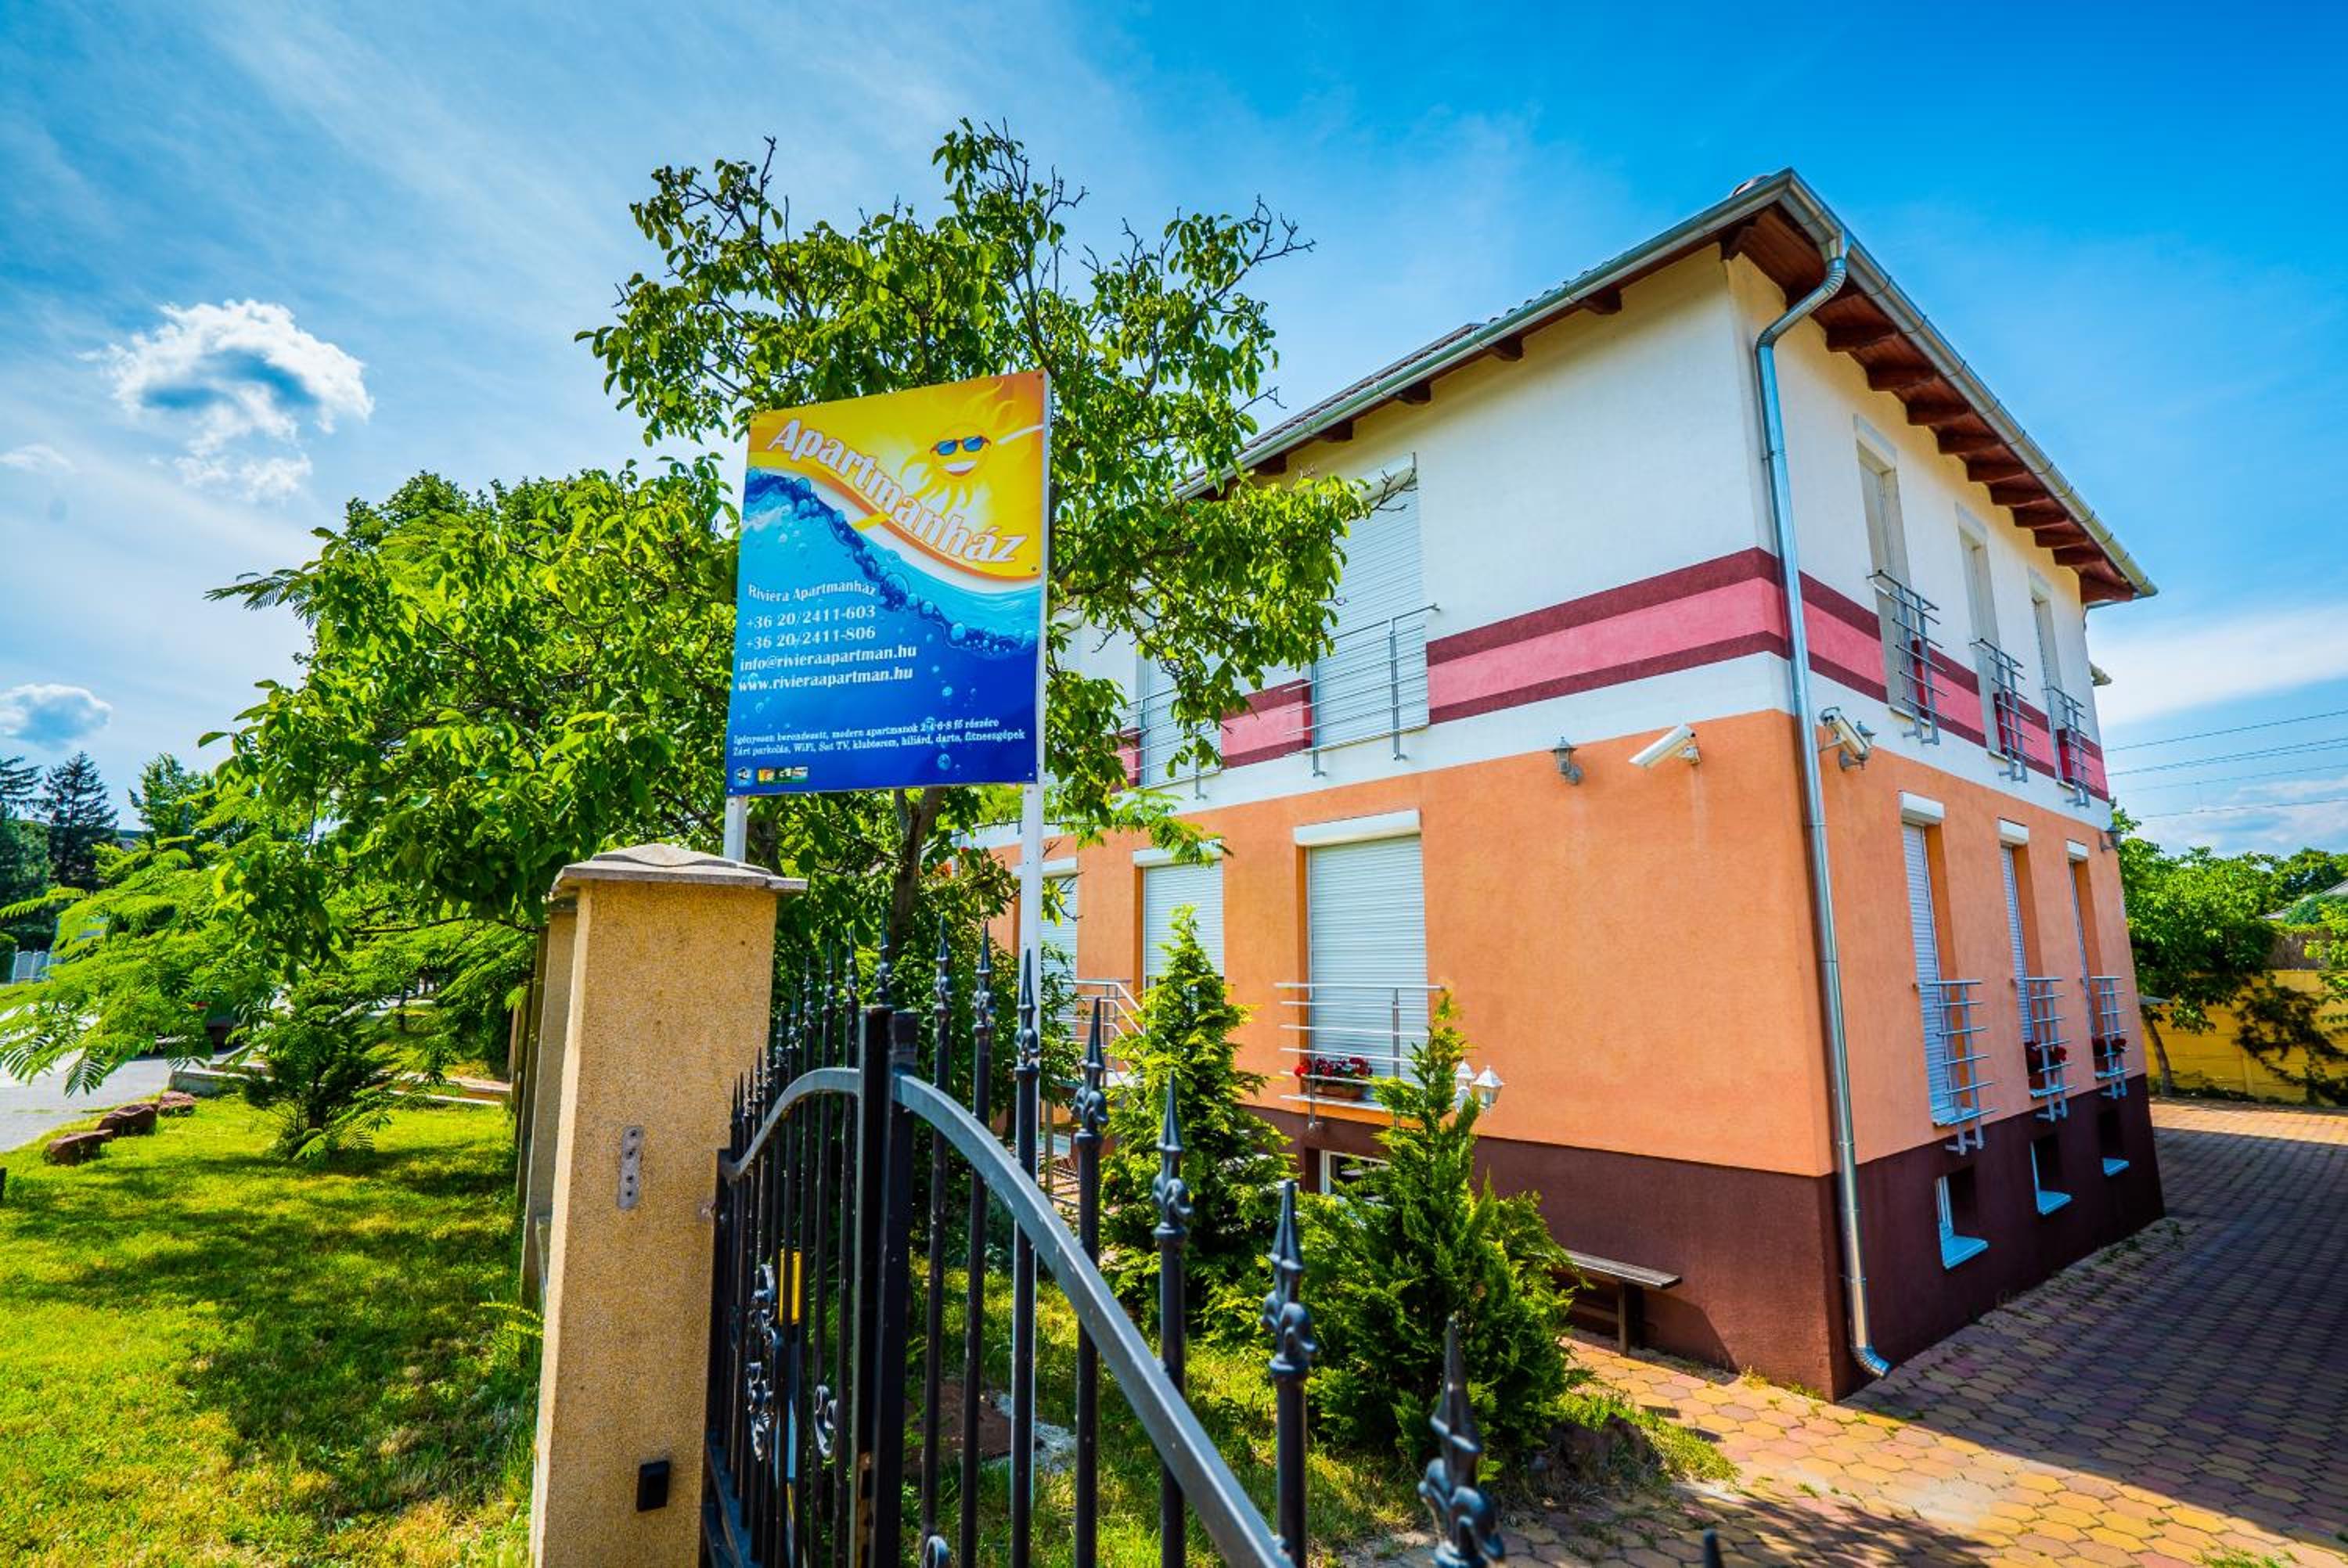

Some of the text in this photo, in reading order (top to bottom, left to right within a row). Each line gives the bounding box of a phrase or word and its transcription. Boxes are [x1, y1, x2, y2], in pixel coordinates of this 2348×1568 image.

[766, 417, 1028, 563] Apartmanház
[793, 581, 877, 601] Apartmanház
[746, 605, 876, 629] +36 20/2411-603
[746, 627, 876, 650] +36 20/2411-806
[740, 645, 917, 672] info@rivieraapartman.hu
[738, 666, 913, 692] www.rivieraapartman.hu
[832, 728, 864, 739] modern
[866, 724, 918, 737] apartmanok
[794, 743, 816, 753] WiFi,
[836, 740, 851, 751] TV,
